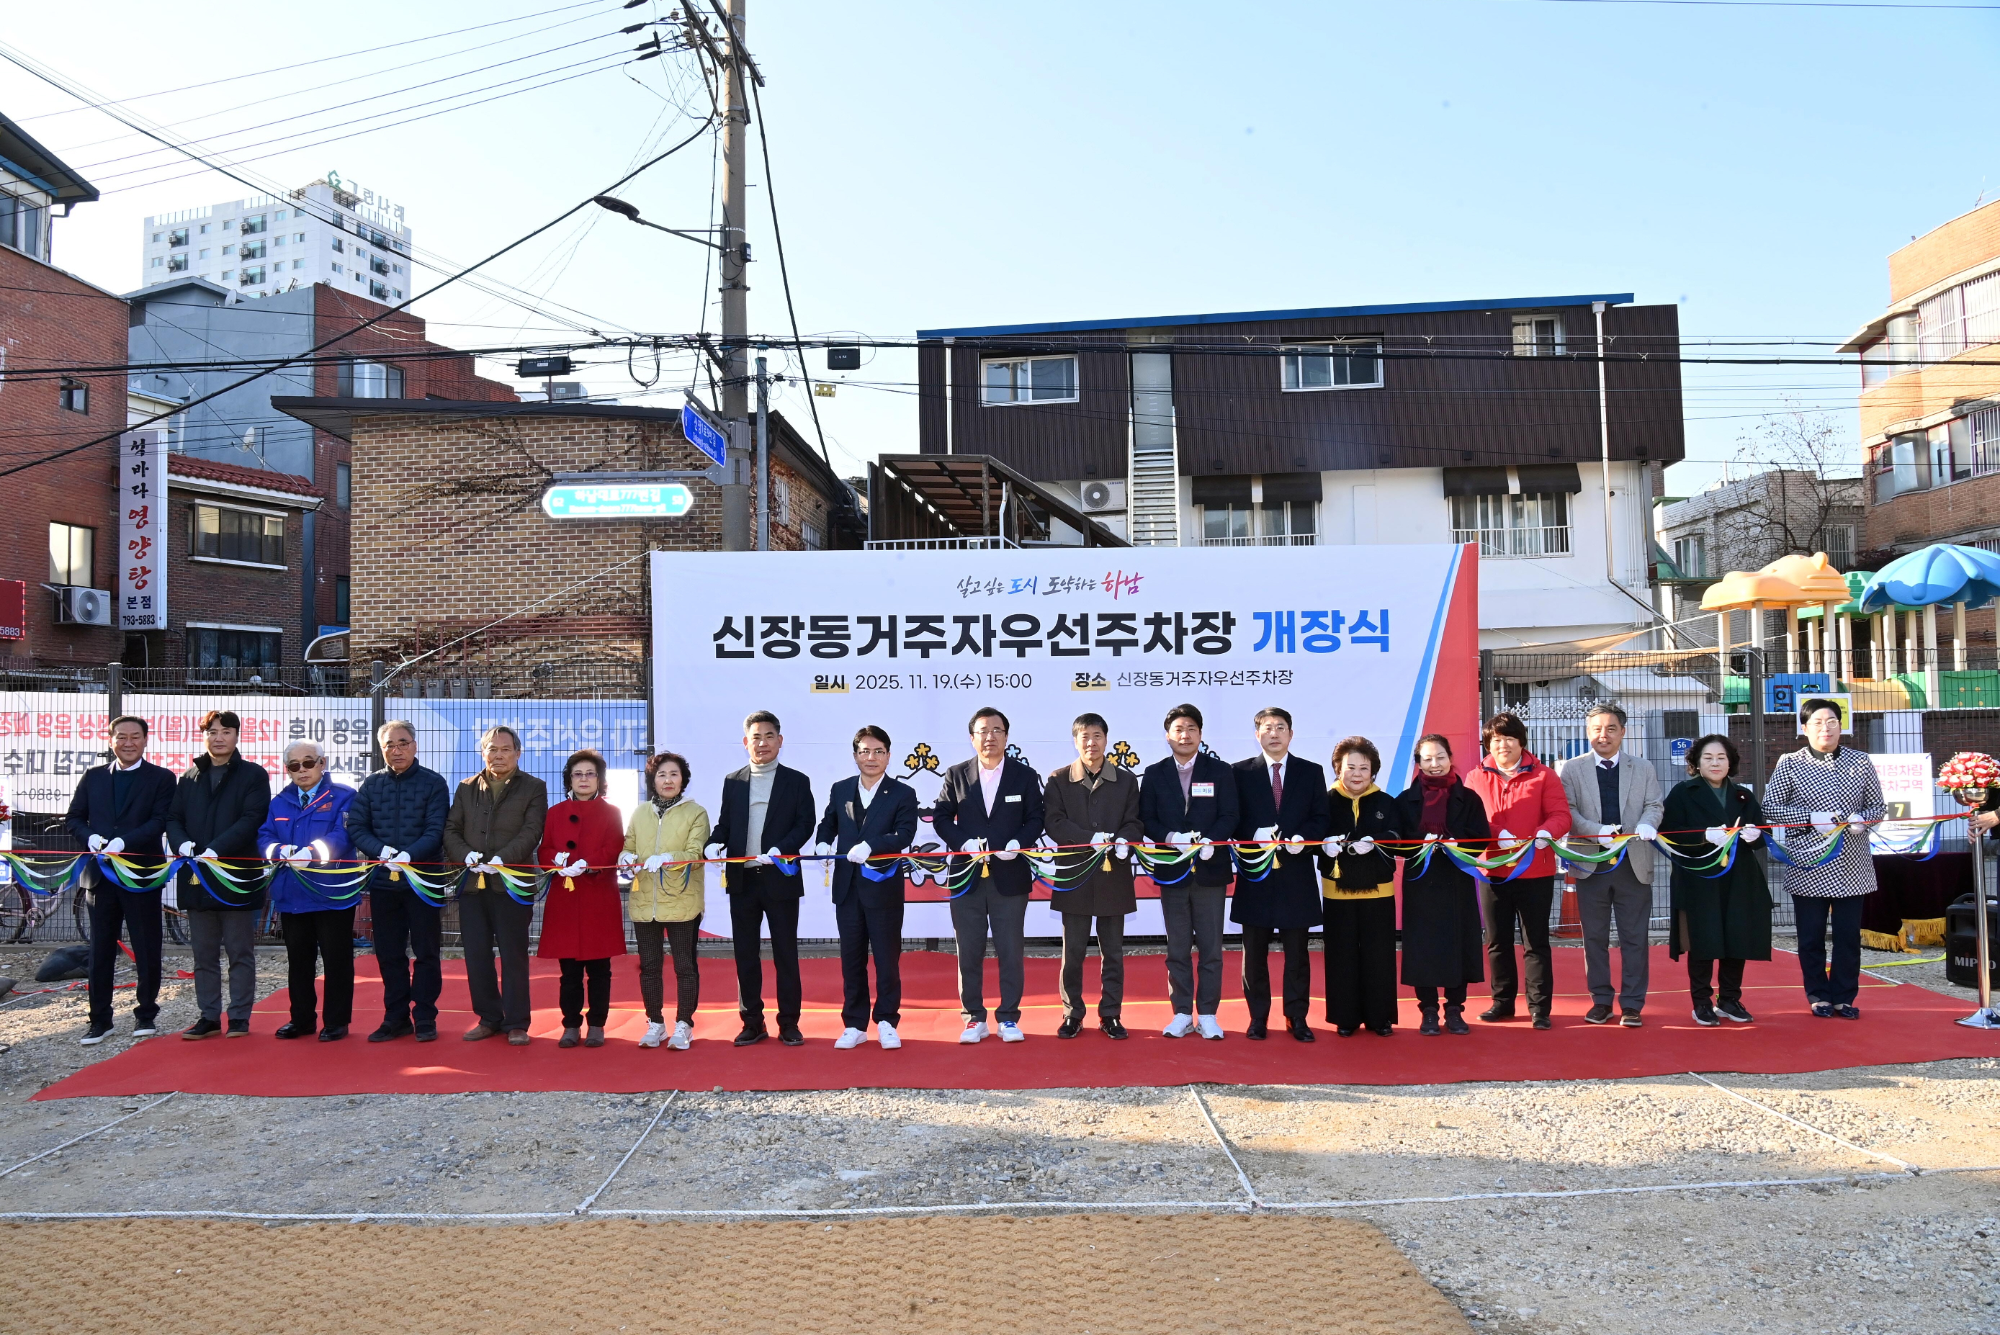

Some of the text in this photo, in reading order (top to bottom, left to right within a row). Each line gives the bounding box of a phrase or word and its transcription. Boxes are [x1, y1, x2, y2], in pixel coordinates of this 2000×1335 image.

[128, 505, 152, 590] 영양탕
[957, 569, 1144, 600] 살고 싶은 도시 도약하는 하남
[126, 595, 152, 610] 본점
[122, 615, 155, 626] 793-5883
[713, 609, 1390, 659] 신장동거주자우선주차장 개장식
[814, 674, 846, 690] 일시
[855, 673, 1032, 690] 2025. 11. 19.(수) 15:00
[1075, 670, 1293, 688] 장소 신장동거주자우선주차장
[1677, 741, 1687, 749] 56
[1894, 803, 1905, 818] 7
[1954, 953, 1997, 970] MIPO
